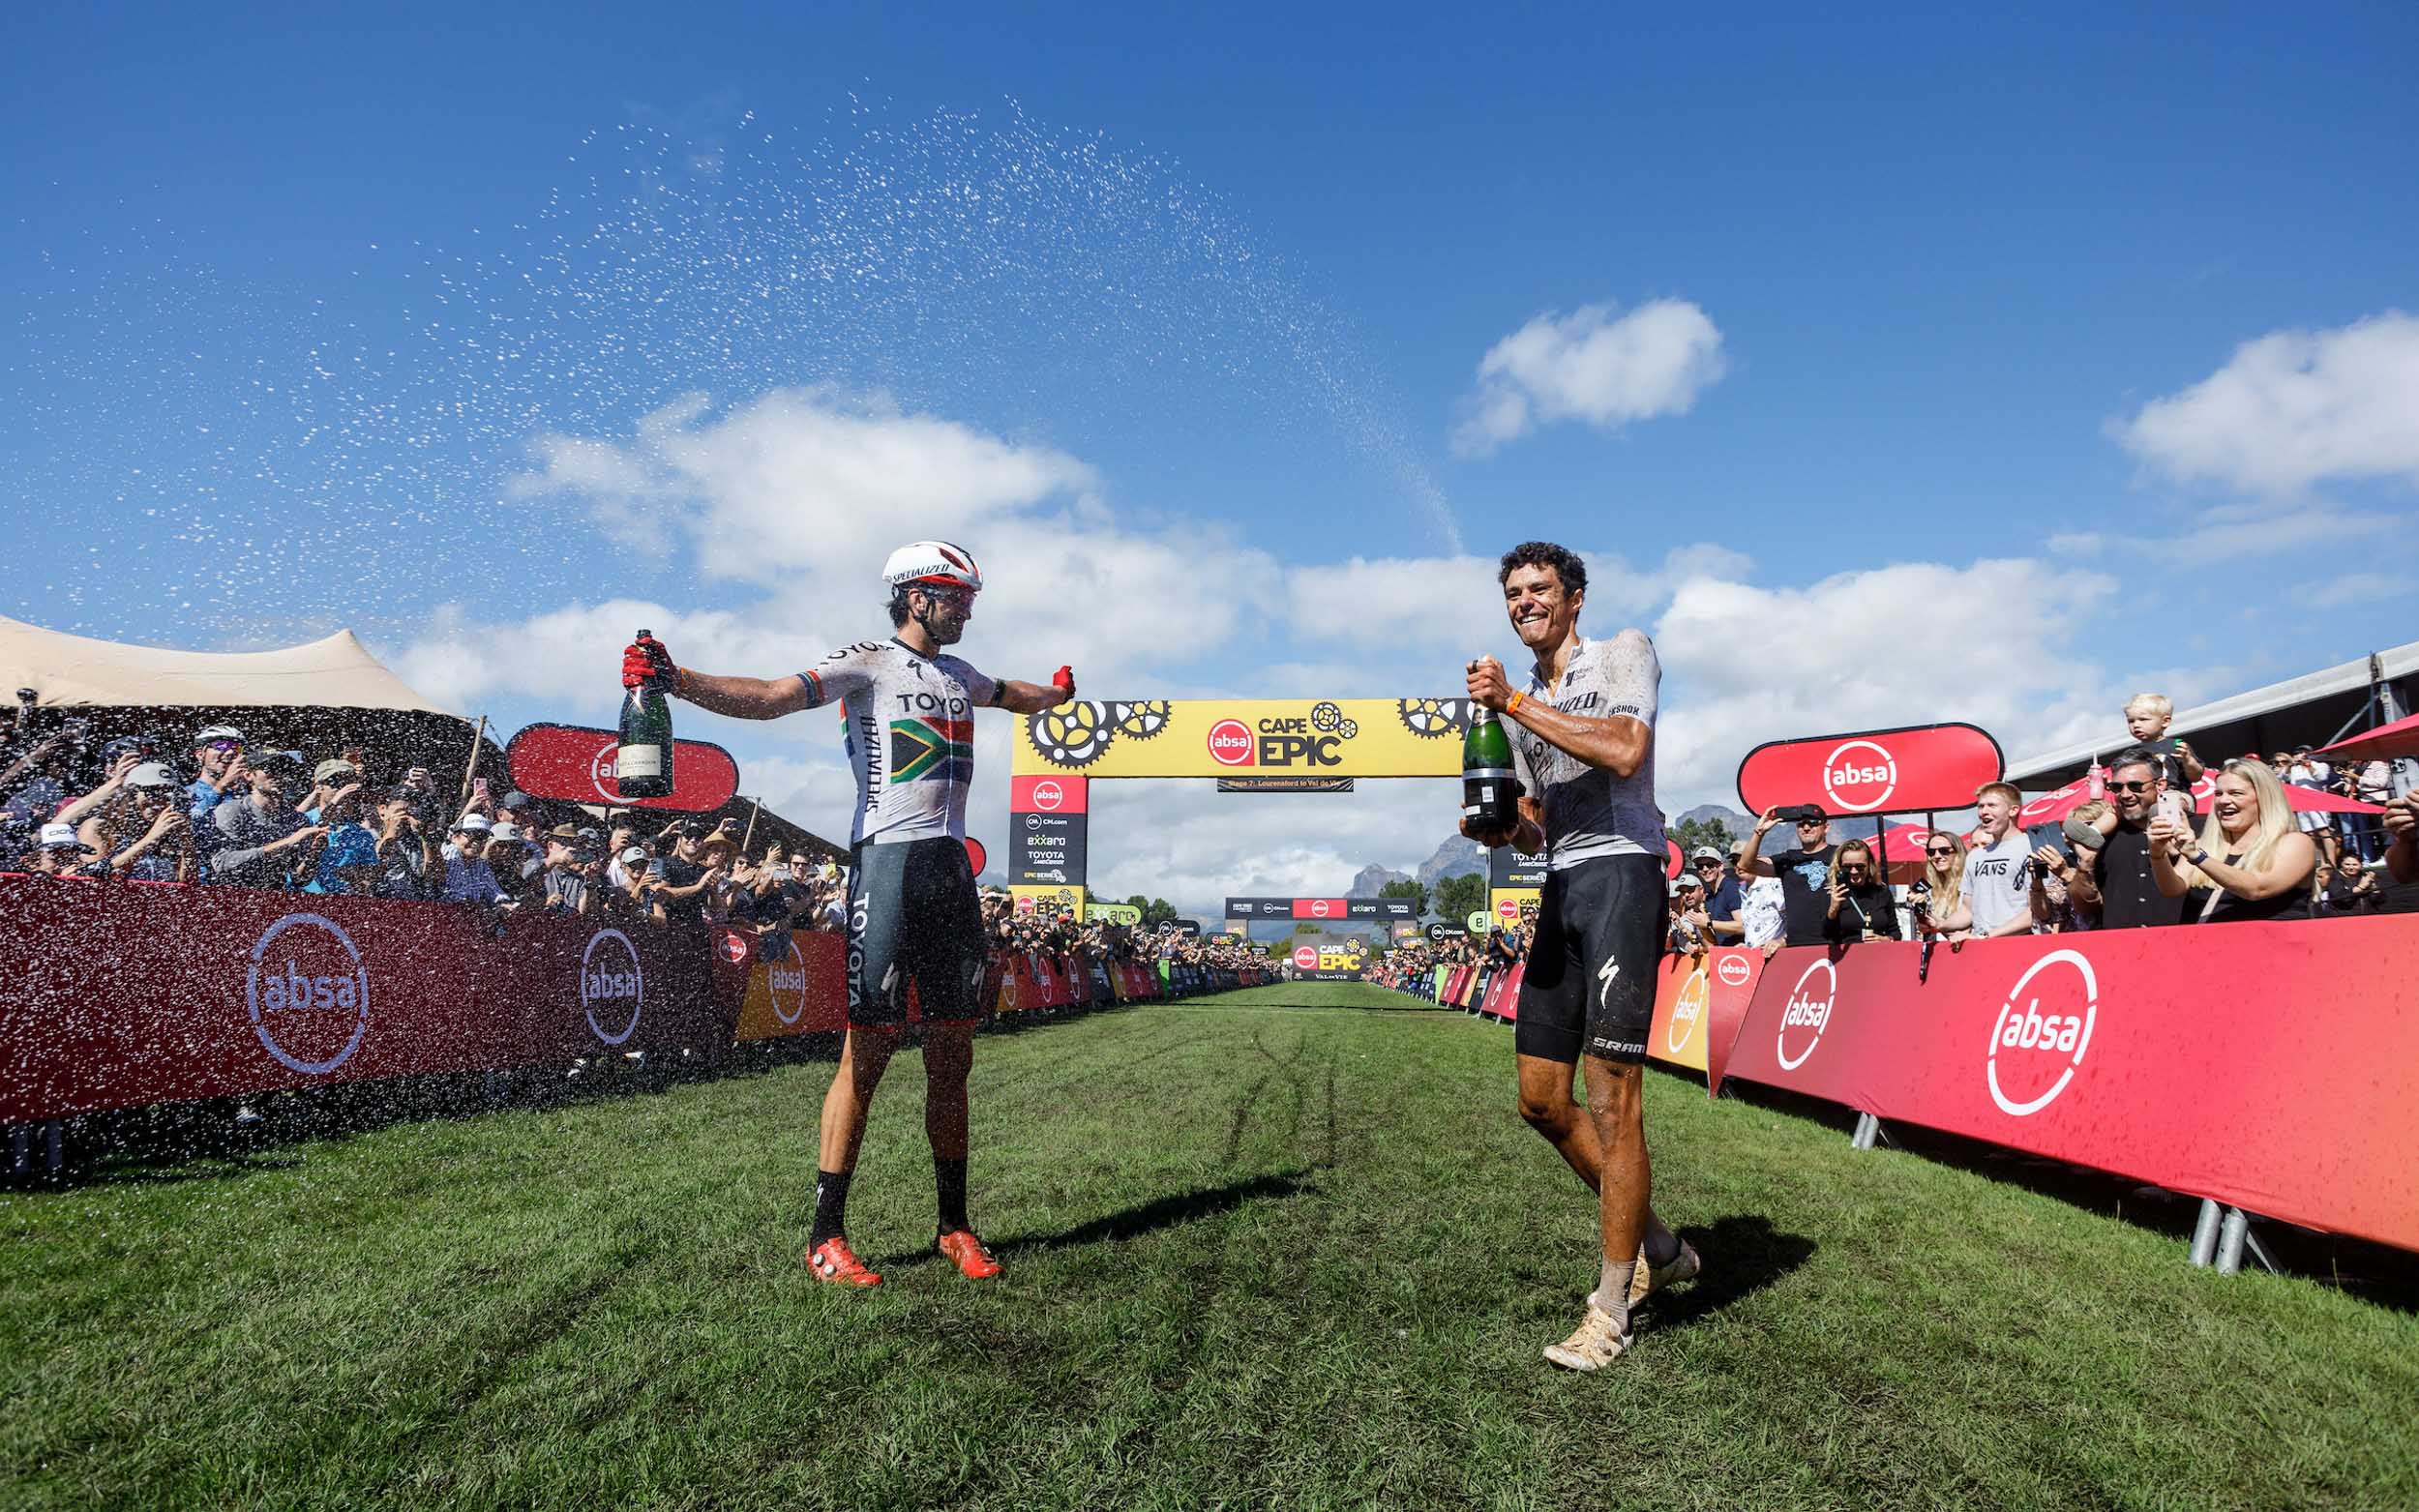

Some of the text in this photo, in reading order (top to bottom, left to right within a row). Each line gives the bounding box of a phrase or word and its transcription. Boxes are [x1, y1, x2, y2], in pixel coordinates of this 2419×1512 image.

[893, 564, 949, 581] SPECIALIZED
[896, 693, 972, 714] TOYOT
[1259, 719, 1306, 733] CAPE
[1214, 733, 1247, 748] absa
[1259, 735, 1342, 766] EPIC
[860, 715, 882, 814] SPECIALIZED
[1833, 762, 1888, 786] absa
[1037, 789, 1059, 799] absa
[1028, 835, 1065, 845] exxaro
[1975, 859, 2010, 877] VANS
[849, 892, 870, 1007] TOYOTA
[1319, 945, 1344, 954] CAPE
[1319, 954, 1360, 970] EPIC
[1721, 964, 1747, 974] absa
[265, 960, 356, 1009] absa
[588, 962, 636, 998] absa
[774, 964, 802, 990] absa
[1676, 993, 1698, 1021] absa
[1788, 992, 1827, 1026] absa
[2002, 998, 2080, 1052] absa
